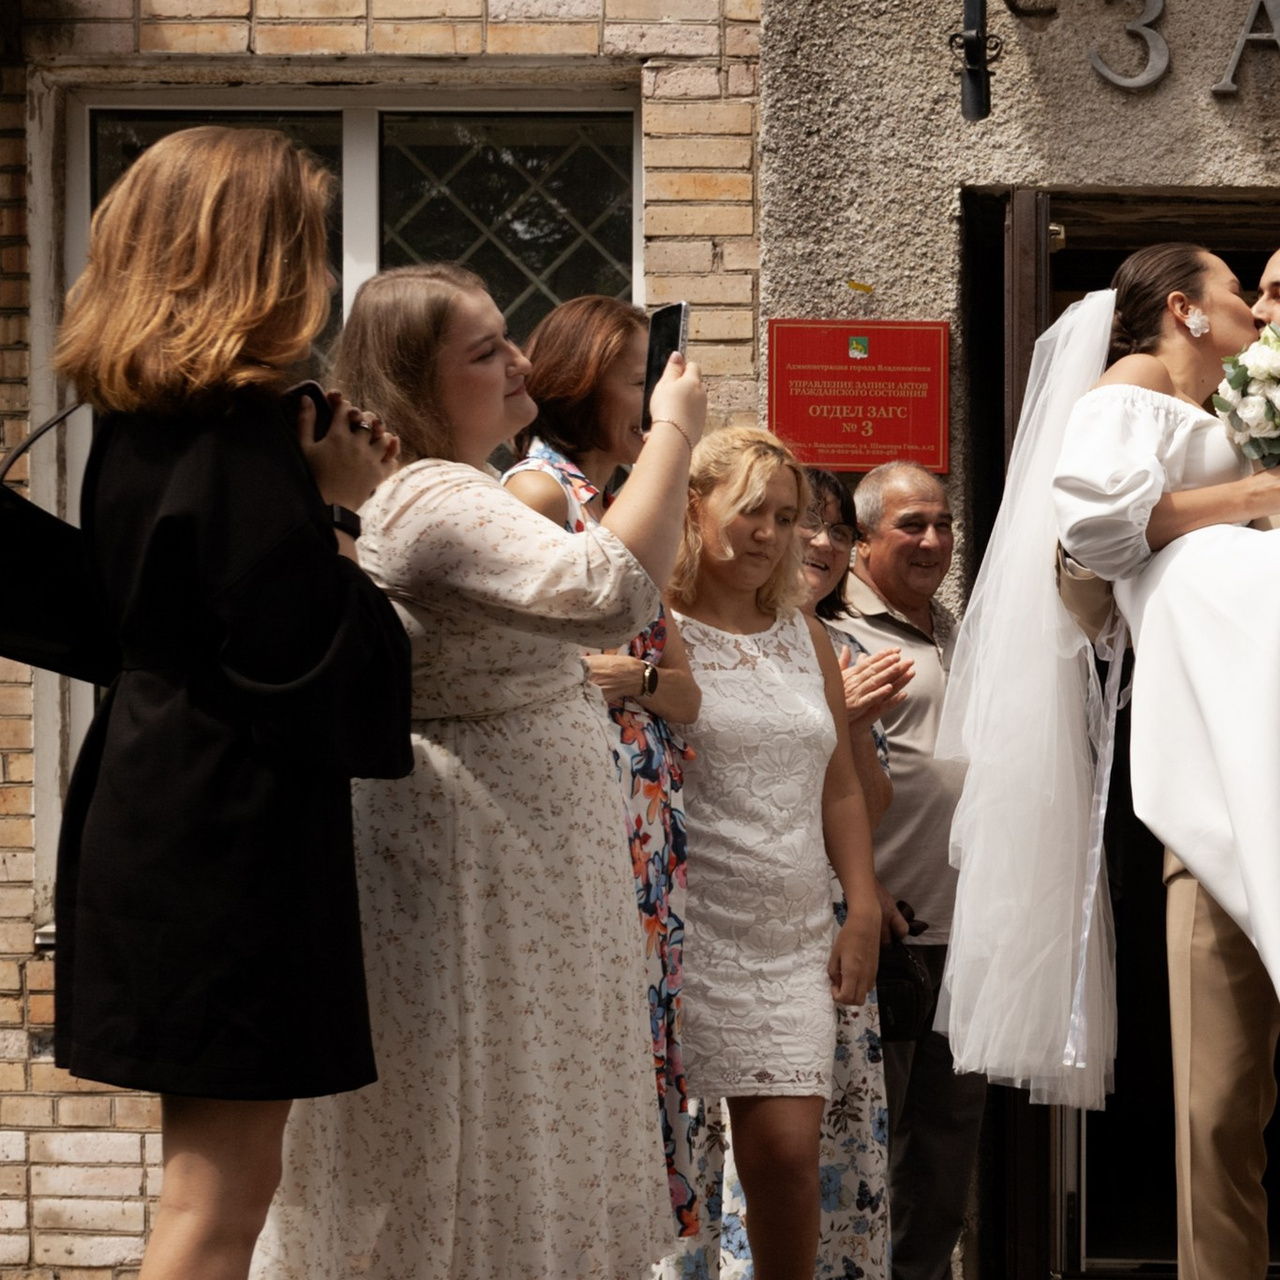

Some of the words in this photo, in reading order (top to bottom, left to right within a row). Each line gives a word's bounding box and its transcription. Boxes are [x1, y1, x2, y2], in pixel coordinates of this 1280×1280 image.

[788, 380, 854, 389] УПРАВЛЕНИЕ
[855, 381, 895, 390] ЗАПИСИ
[897, 382, 929, 390] АКТОВ
[789, 388, 867, 397] ГРАЖДАНСКОГО
[868, 389, 927, 398] СОСТОЯНИЯ
[808, 405, 863, 418] ОТДЕЛ
[867, 406, 908, 418] ЗАГС
[841, 422, 857, 433] №
[861, 420, 874, 437] 3
